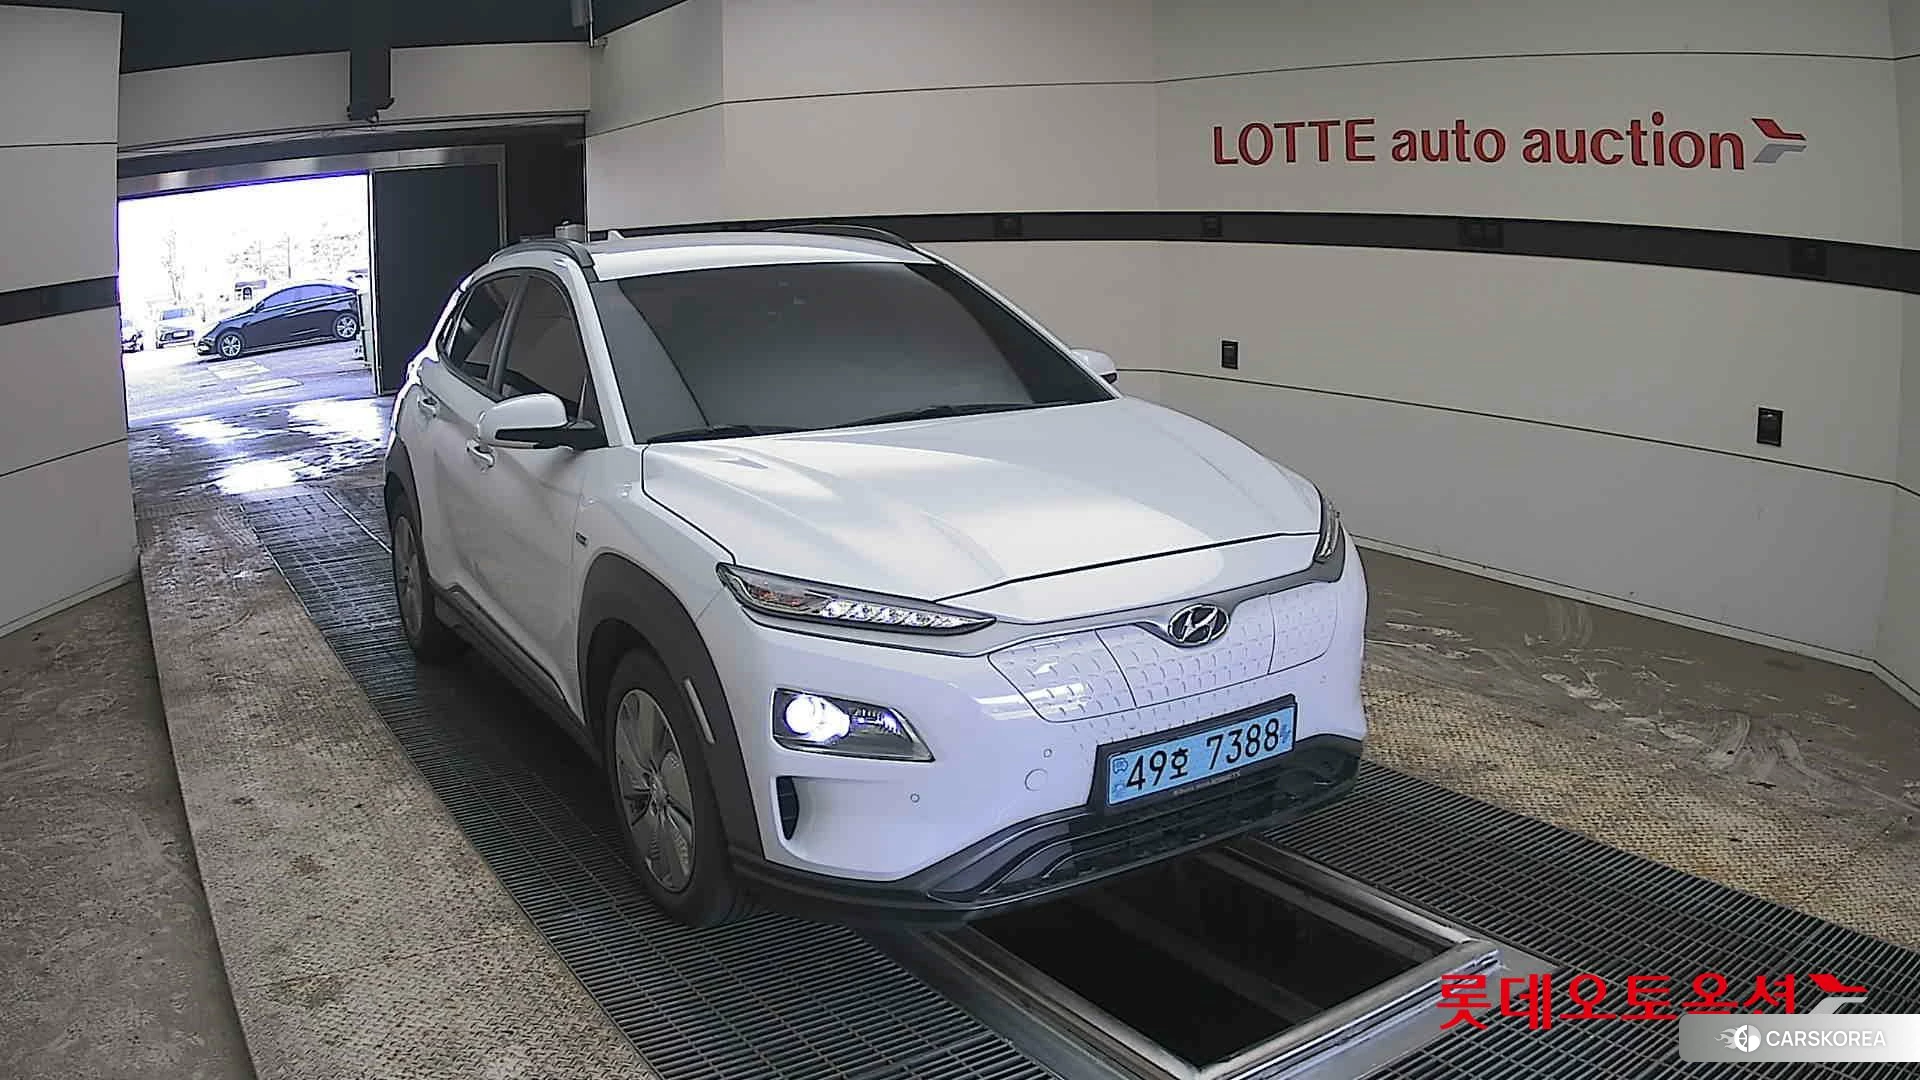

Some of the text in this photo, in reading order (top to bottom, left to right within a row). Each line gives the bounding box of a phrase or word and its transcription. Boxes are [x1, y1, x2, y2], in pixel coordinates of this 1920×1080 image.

[1213, 111, 1745, 170] LOTTE auto auction
[1126, 747, 1189, 791] 49호
[1206, 717, 1280, 770] 7388
